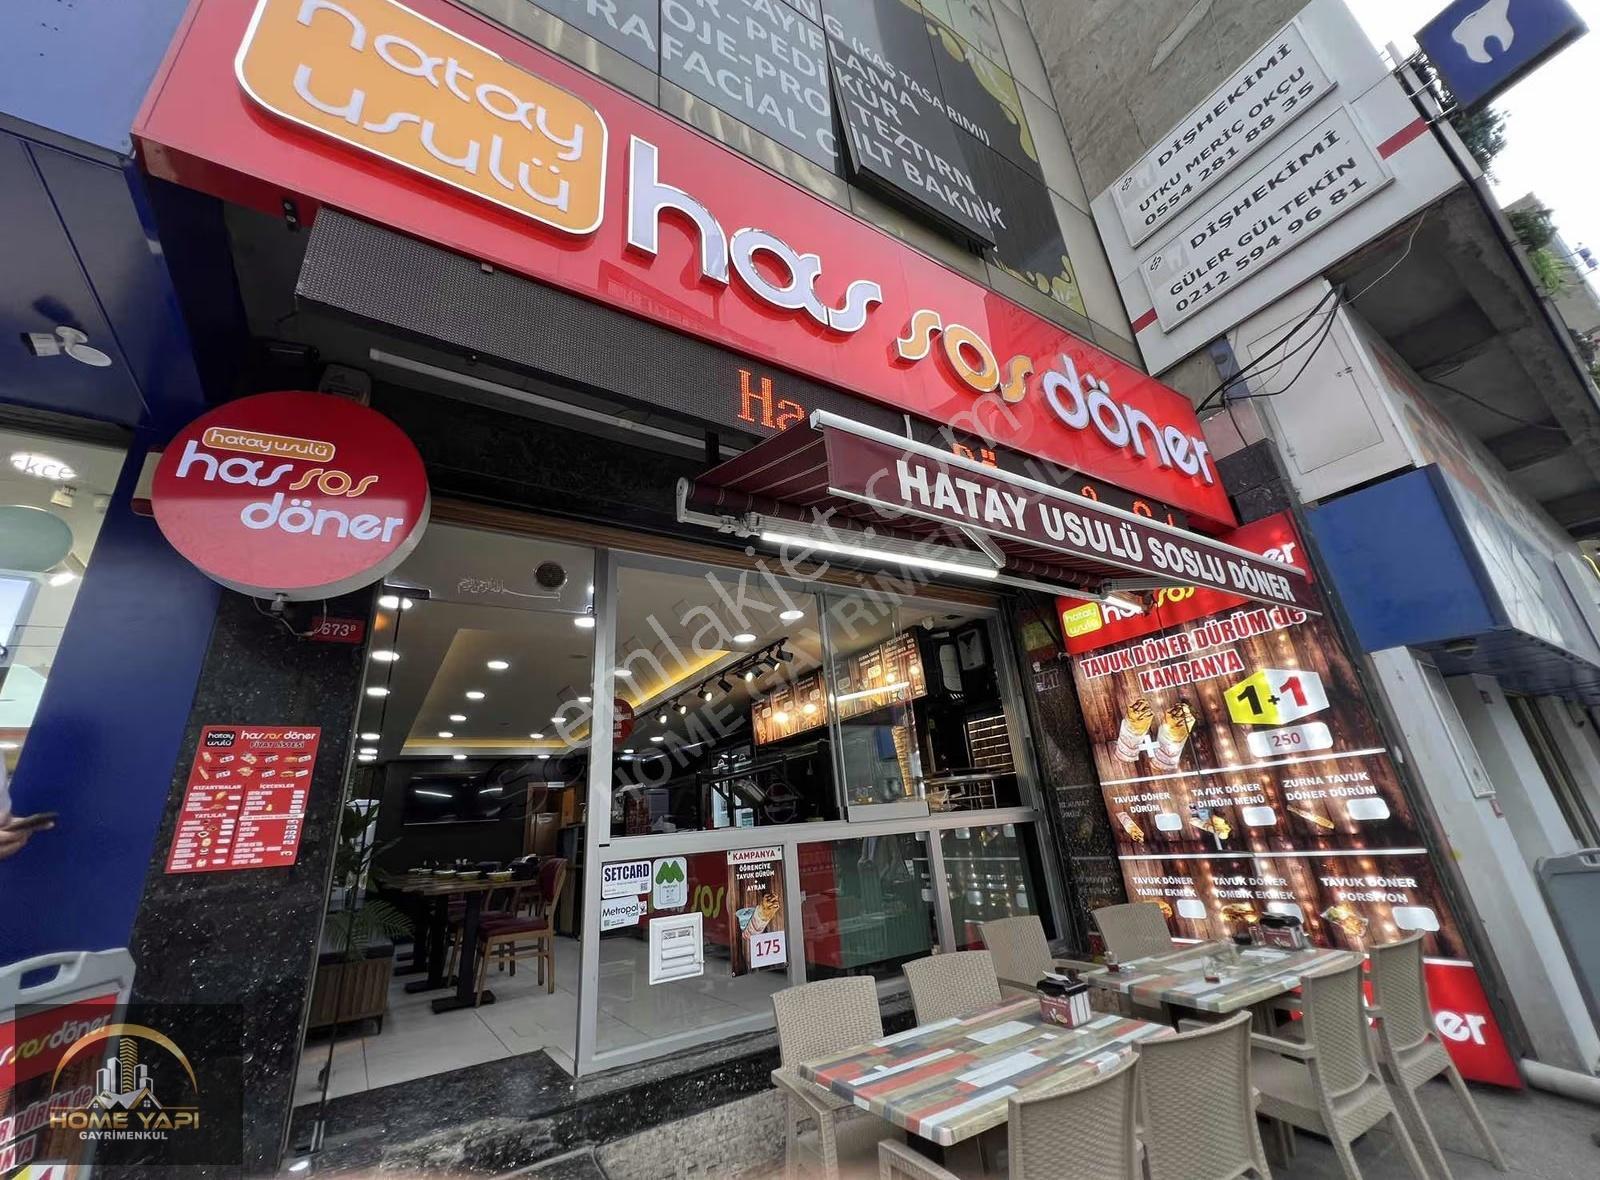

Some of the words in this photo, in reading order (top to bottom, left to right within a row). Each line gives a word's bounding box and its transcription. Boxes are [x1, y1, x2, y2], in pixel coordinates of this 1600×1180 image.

[1157, 42, 1294, 168] DİŞHEKİMİ
[293, 63, 570, 213] usulü
[1138, 173, 1193, 213] UTKU
[1186, 118, 1246, 179] MERİÇ
[1247, 67, 1306, 122] OKÇU
[1144, 184, 1194, 227] 0554
[1199, 145, 1239, 183] 281
[1245, 113, 1276, 142] 88
[1283, 81, 1316, 113] 35
[1189, 129, 1341, 251] DİŞHEKİMİ
[1168, 245, 1232, 297] GÜLER
[1236, 157, 1357, 248] GÜLTEKİN
[1174, 270, 1231, 313] 0212
[1235, 235, 1282, 275] 594
[1286, 206, 1321, 236] 96
[1329, 178, 1367, 205] 81
[626, 132, 884, 334] has
[896, 309, 1035, 404] sos
[1041, 354, 1215, 487] döner
[210, 428, 274, 454] hatay
[274, 438, 330, 459] usulü
[175, 439, 293, 488] has
[288, 467, 380, 498] sos
[240, 491, 404, 543] döner
[896, 459, 1028, 533] HATAY
[1037, 502, 1144, 562] USULÜ
[1147, 535, 1227, 585] SOSLU
[1226, 559, 1297, 603] DÖNER
[1081, 649, 1134, 679] TAVUK
[1131, 633, 1193, 667] DÖNER
[1191, 608, 1273, 650] DÜRÜM
[1138, 648, 1245, 693] KAMPANYA
[1271, 731, 1301, 748] 250
[1224, 783, 1262, 795] DÖNER
[1282, 777, 1324, 789] ZURNA
[1326, 771, 1371, 784] TAVUK
[1113, 795, 1140, 804] TAVUK
[1141, 792, 1171, 802] DÖNER
[1233, 793, 1266, 806] MENÜ
[1285, 788, 1328, 801] DÖNER
[1328, 784, 1378, 798] DÜRÜM
[1130, 804, 1161, 814] DÜRÜM
[732, 850, 776, 861] KAMPANYA
[604, 863, 650, 882] SETCARD
[736, 872, 755, 880] TAVUK
[1132, 876, 1162, 885] TAVUK
[1163, 875, 1194, 885] DÖNER
[1212, 876, 1248, 887] TAVUK
[1320, 877, 1365, 888] TAVUK
[1365, 875, 1418, 888] DÖNER
[746, 883, 766, 892] AYRAN
[1165, 888, 1198, 898] EKMEK
[602, 904, 639, 917] Metropol
[755, 938, 780, 957] 175
